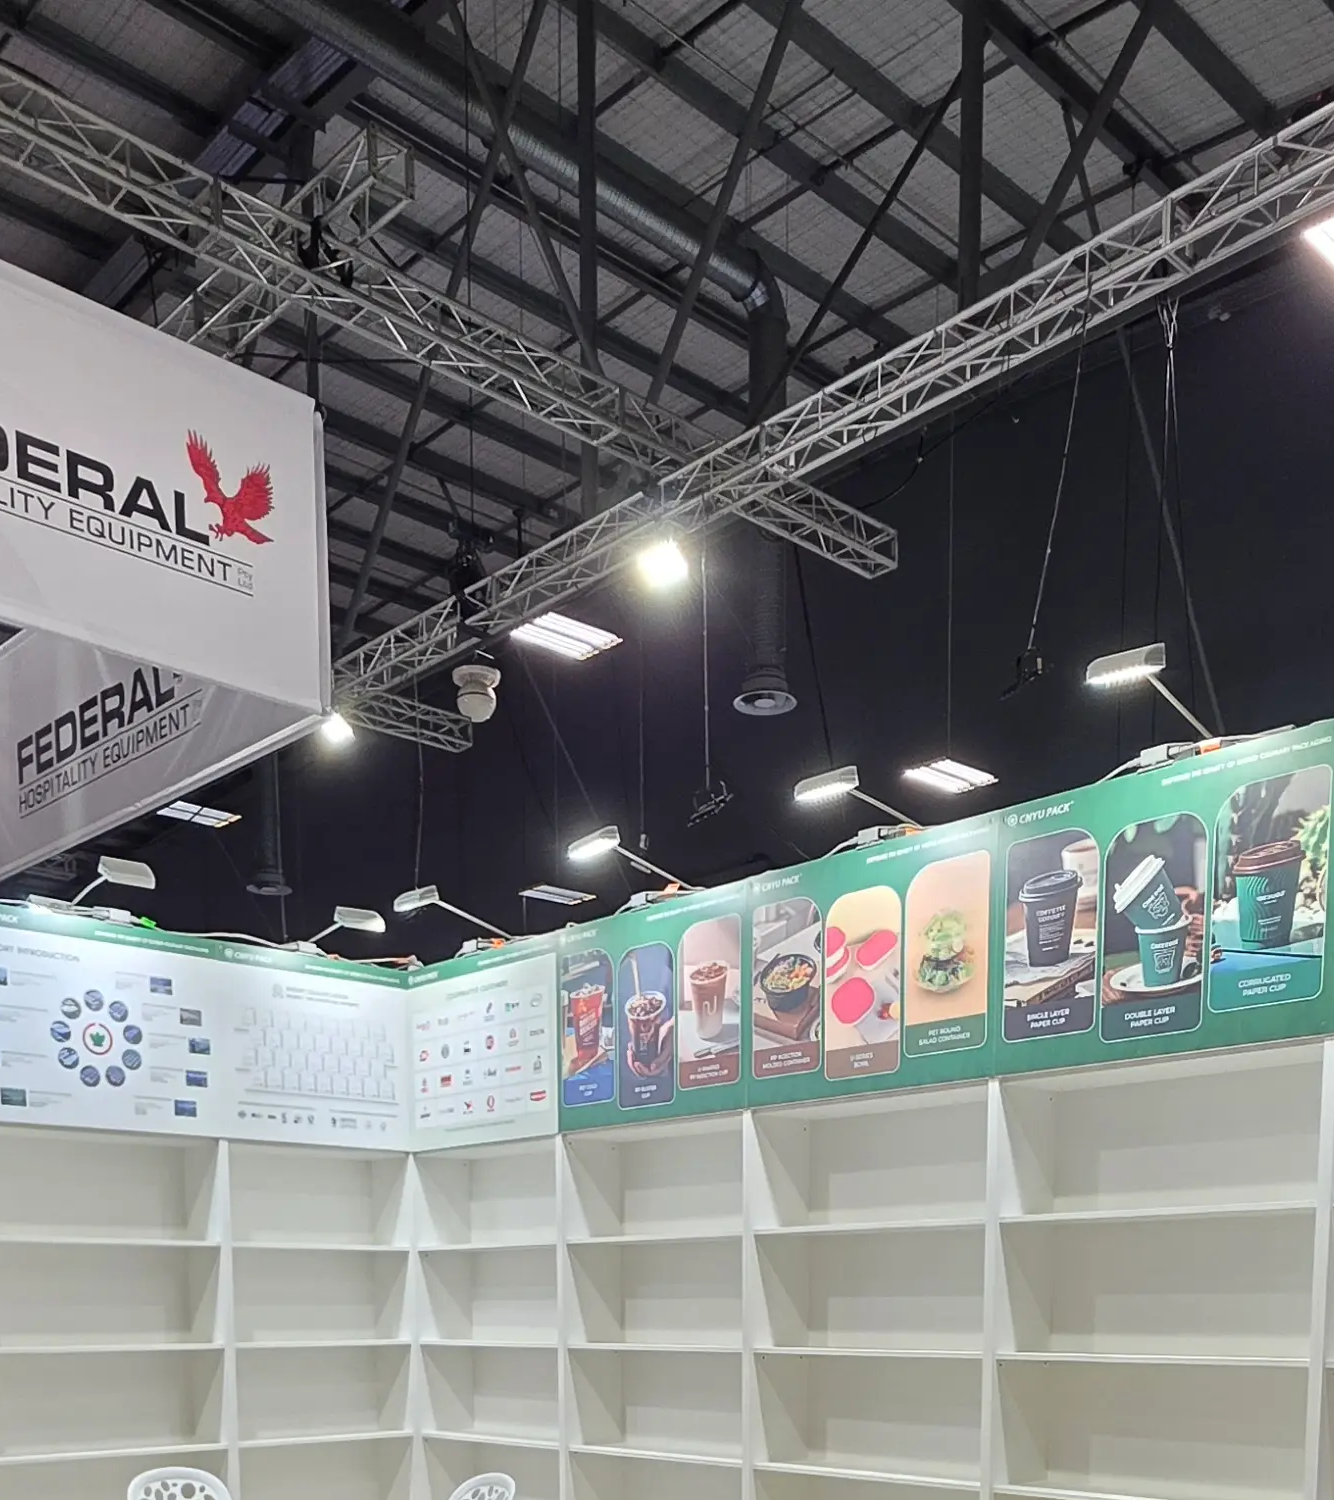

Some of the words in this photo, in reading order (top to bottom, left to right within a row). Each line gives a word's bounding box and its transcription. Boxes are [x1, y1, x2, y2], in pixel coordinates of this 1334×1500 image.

[69, 511, 233, 582] EQUIPMENT
[17, 666, 175, 785] FEDERAL
[18, 752, 98, 814] HOSPITALITY
[102, 703, 190, 769] EQUIPMENT
[1019, 809, 1045, 824] CNYU
[1045, 802, 1071, 818] PACK
[1269, 983, 1287, 992] CUP
[1124, 1010, 1153, 1020] DOUBLE
[1154, 1006, 1176, 1016] LAYER
